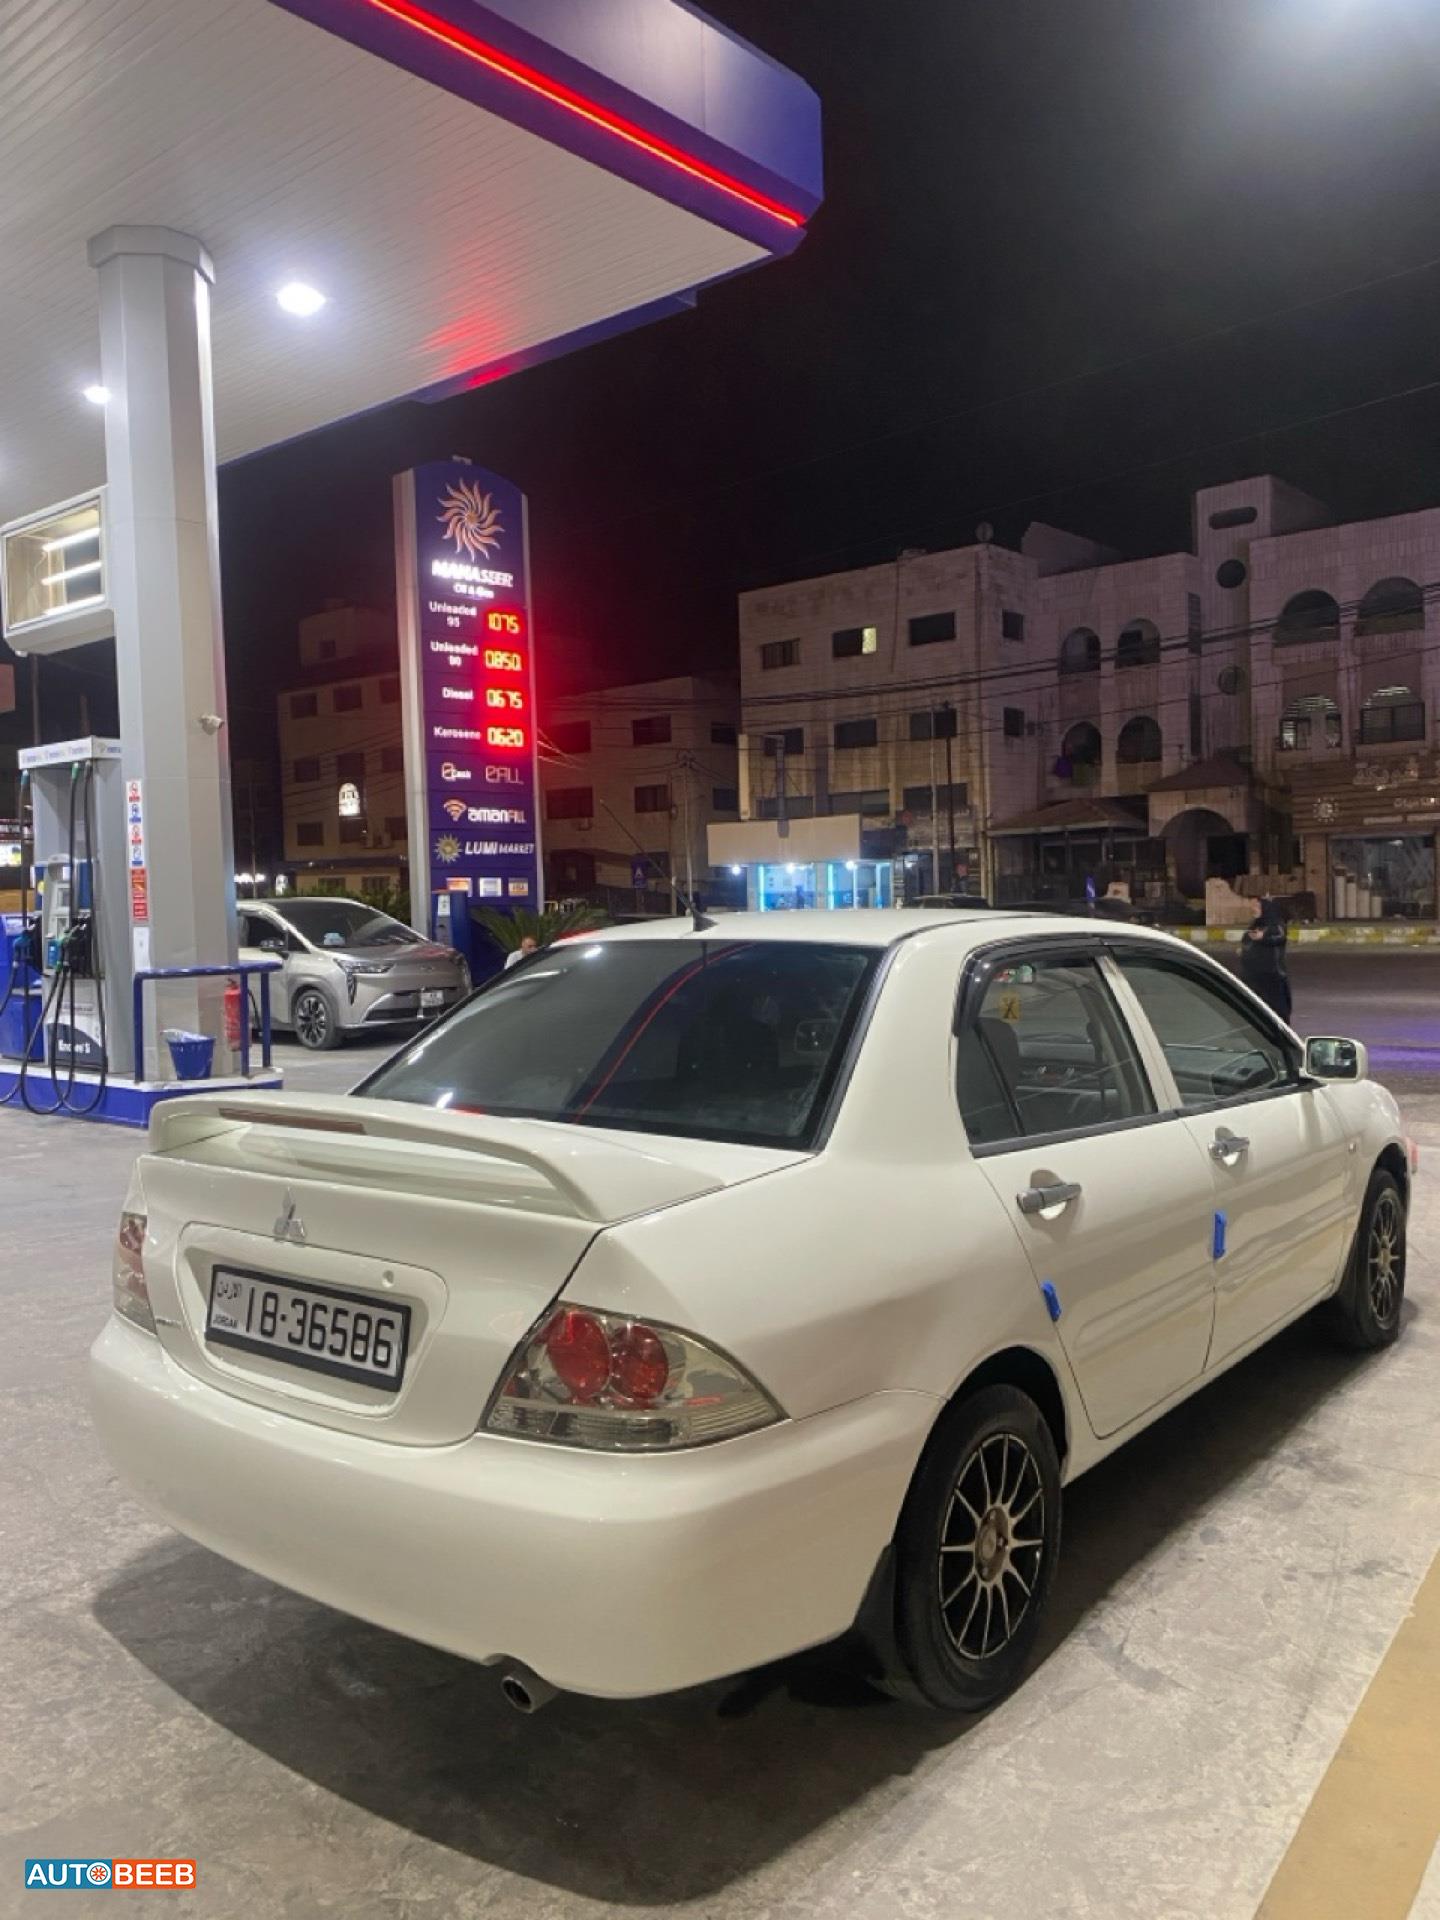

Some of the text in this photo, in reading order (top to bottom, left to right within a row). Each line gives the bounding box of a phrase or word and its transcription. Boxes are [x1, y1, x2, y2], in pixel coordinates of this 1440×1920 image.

[429, 601, 477, 616] Unleaded
[430, 641, 478, 656] Unleaded
[442, 686, 523, 710] Diesel 0675
[433, 726, 524, 749] Kerosene 0620
[464, 841, 535, 855] LUMI MARKET
